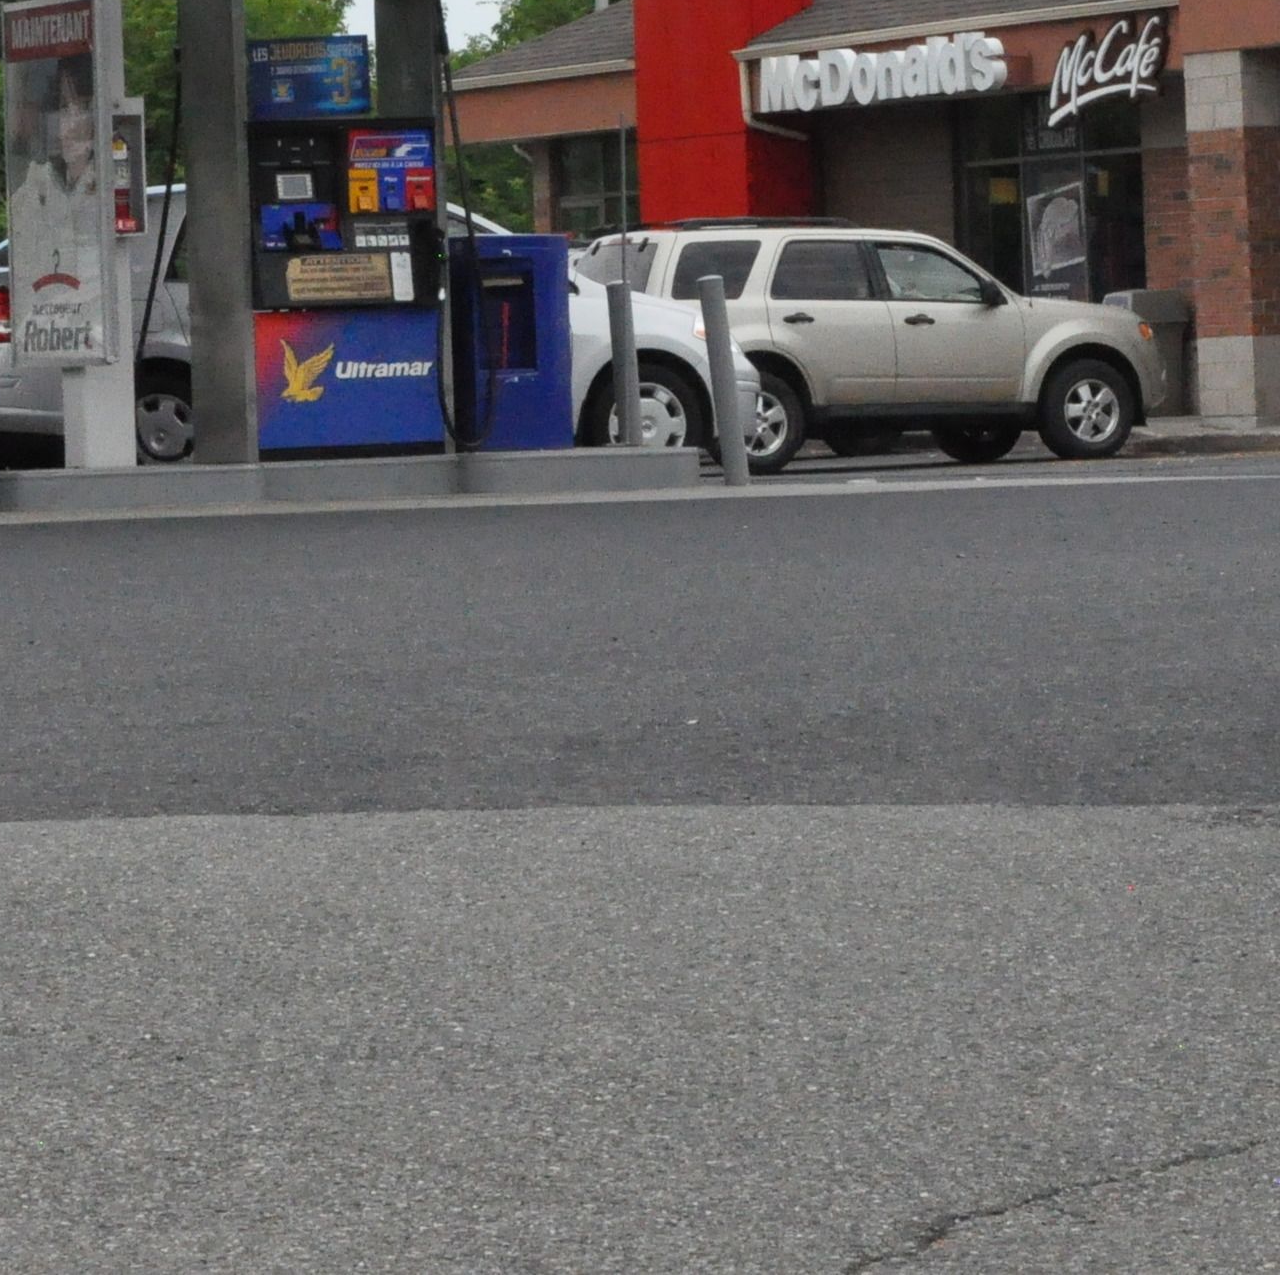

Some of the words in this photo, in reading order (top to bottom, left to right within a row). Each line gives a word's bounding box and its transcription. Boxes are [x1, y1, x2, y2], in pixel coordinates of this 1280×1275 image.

[11, 9, 90, 50] MAINTENANT
[760, 31, 1008, 113] McDonald's
[1048, 16, 1163, 126] McCafé
[24, 320, 93, 353] Robert
[335, 361, 433, 379] Ultramar
